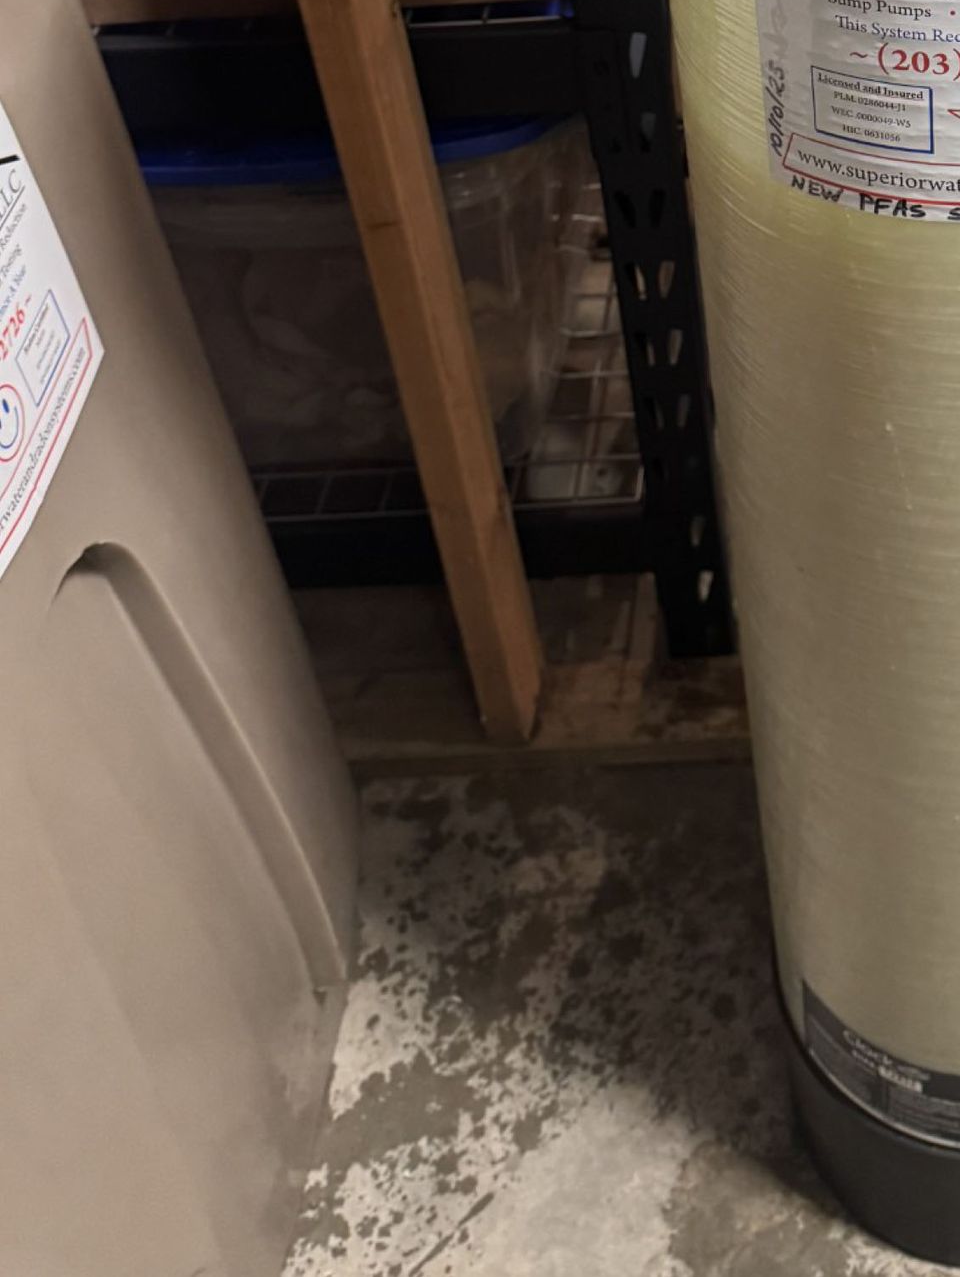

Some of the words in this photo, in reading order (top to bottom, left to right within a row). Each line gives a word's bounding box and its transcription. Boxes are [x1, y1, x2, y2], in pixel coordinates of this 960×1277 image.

[877, 0, 932, 21] Pumps
[835, 14, 867, 34] This
[871, 22, 927, 41] System
[817, 72, 861, 93] Licensed
[862, 84, 882, 95] and
[884, 87, 924, 100] Insured
[791, 175, 844, 202] NEW
[859, 193, 926, 219] PFAS
